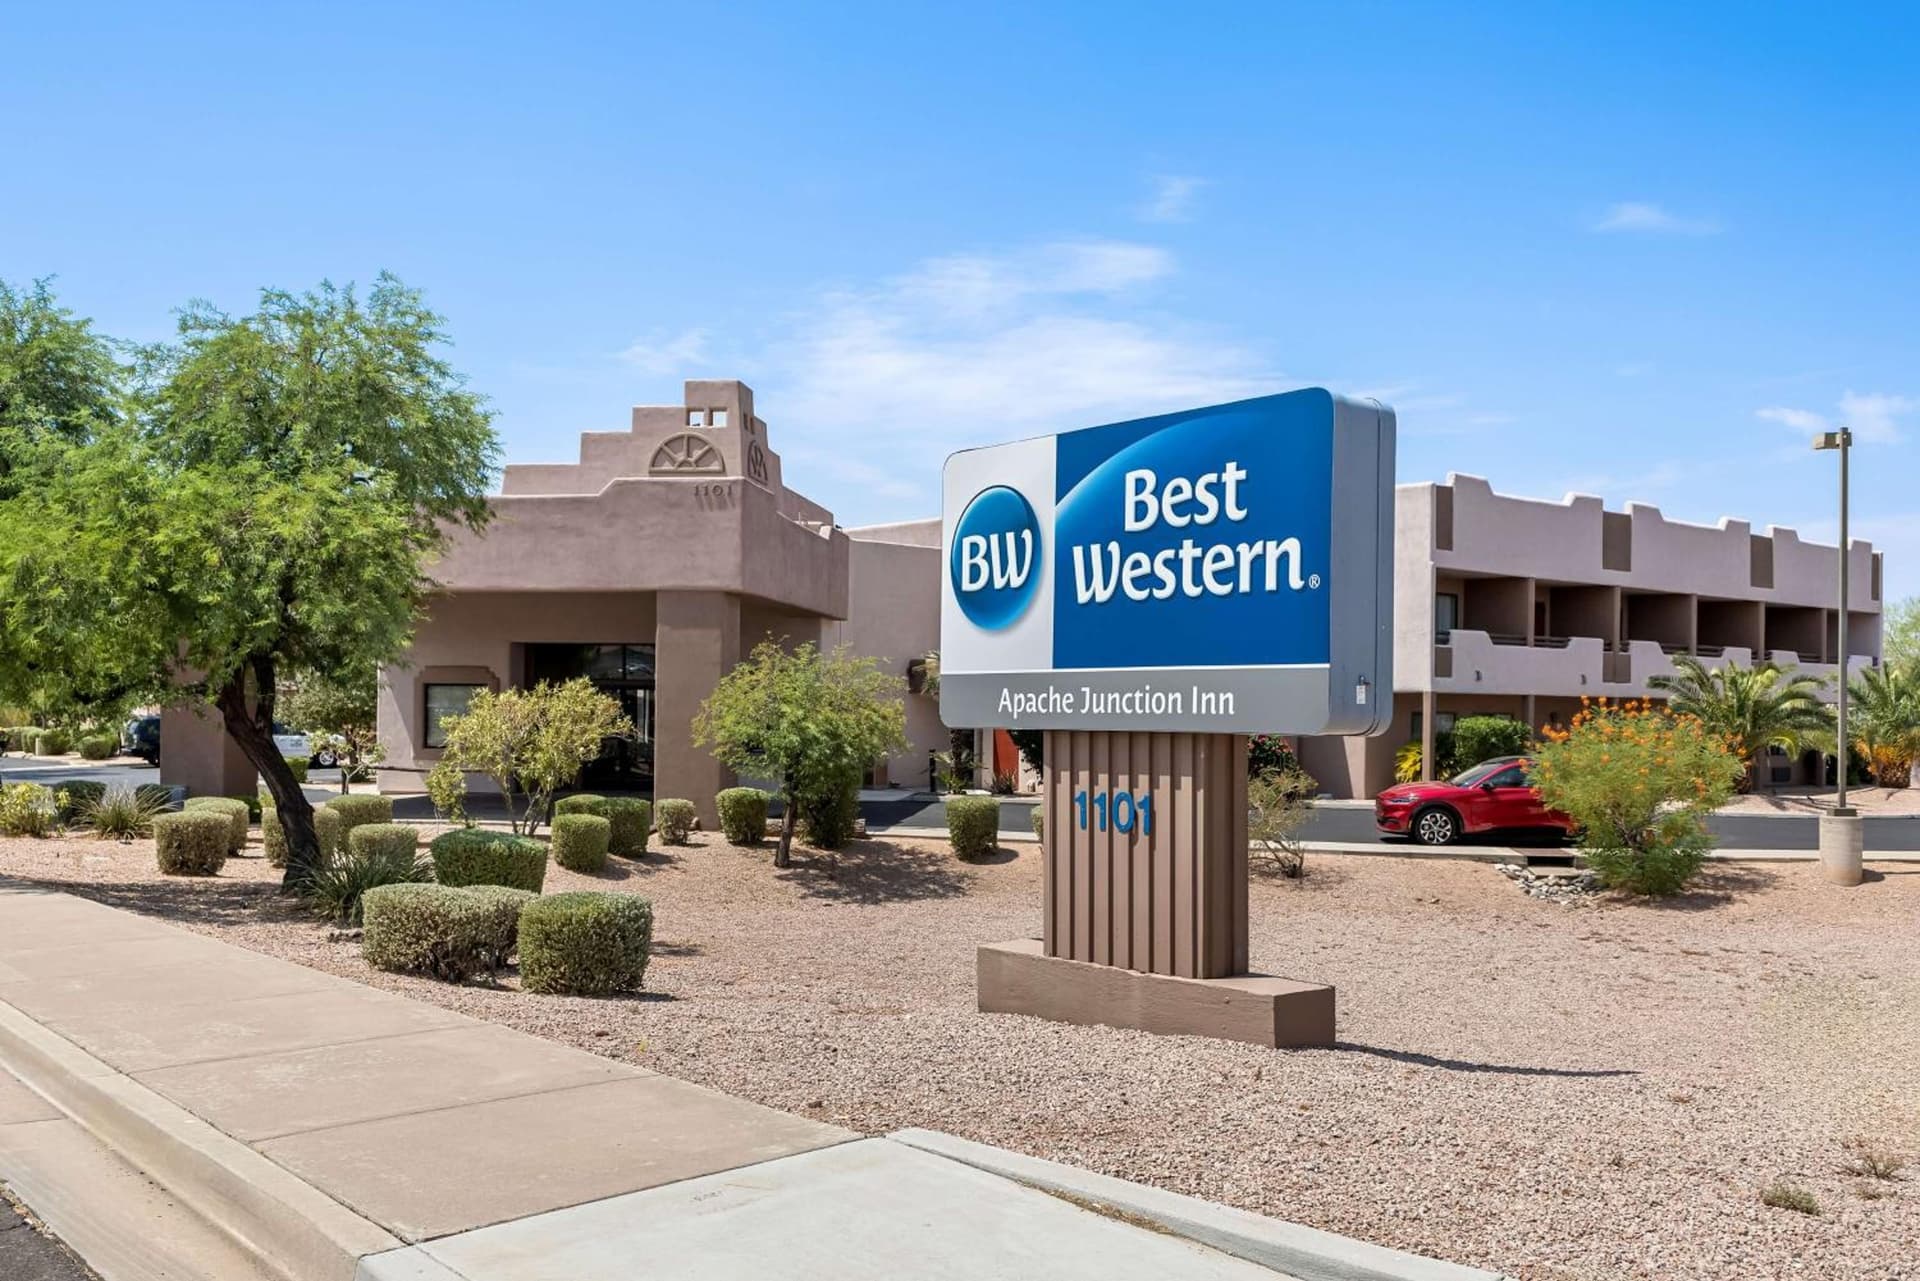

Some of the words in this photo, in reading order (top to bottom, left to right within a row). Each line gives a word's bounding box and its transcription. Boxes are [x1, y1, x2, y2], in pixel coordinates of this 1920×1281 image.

[694, 484, 733, 497] 1101
[1124, 462, 1248, 532] Best
[961, 529, 1033, 591] BW
[998, 686, 1074, 718] Apache
[1080, 685, 1183, 715] Junction
[1191, 686, 1235, 714] Inn
[1074, 791, 1152, 836] 1101
